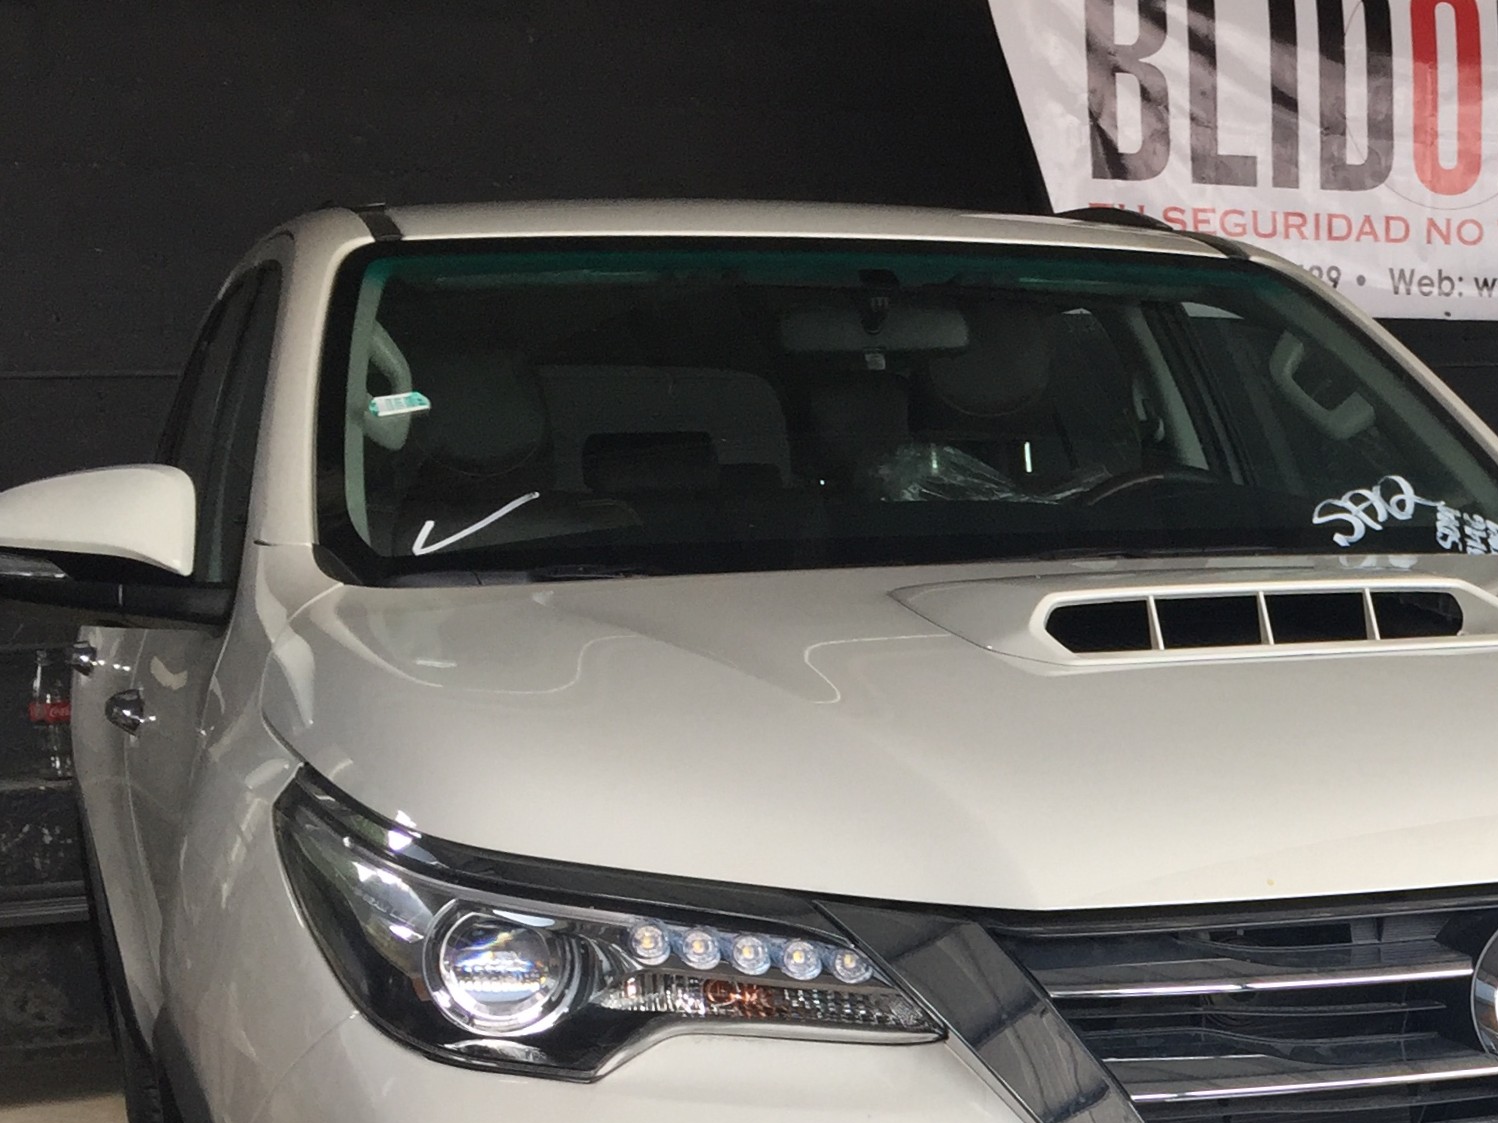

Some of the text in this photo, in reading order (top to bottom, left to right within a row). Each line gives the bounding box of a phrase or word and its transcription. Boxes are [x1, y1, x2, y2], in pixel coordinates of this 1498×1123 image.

[1162, 206, 1411, 243] SEGURIDAD
[1425, 217, 1484, 247] NO
[1389, 267, 1464, 298] Web:
